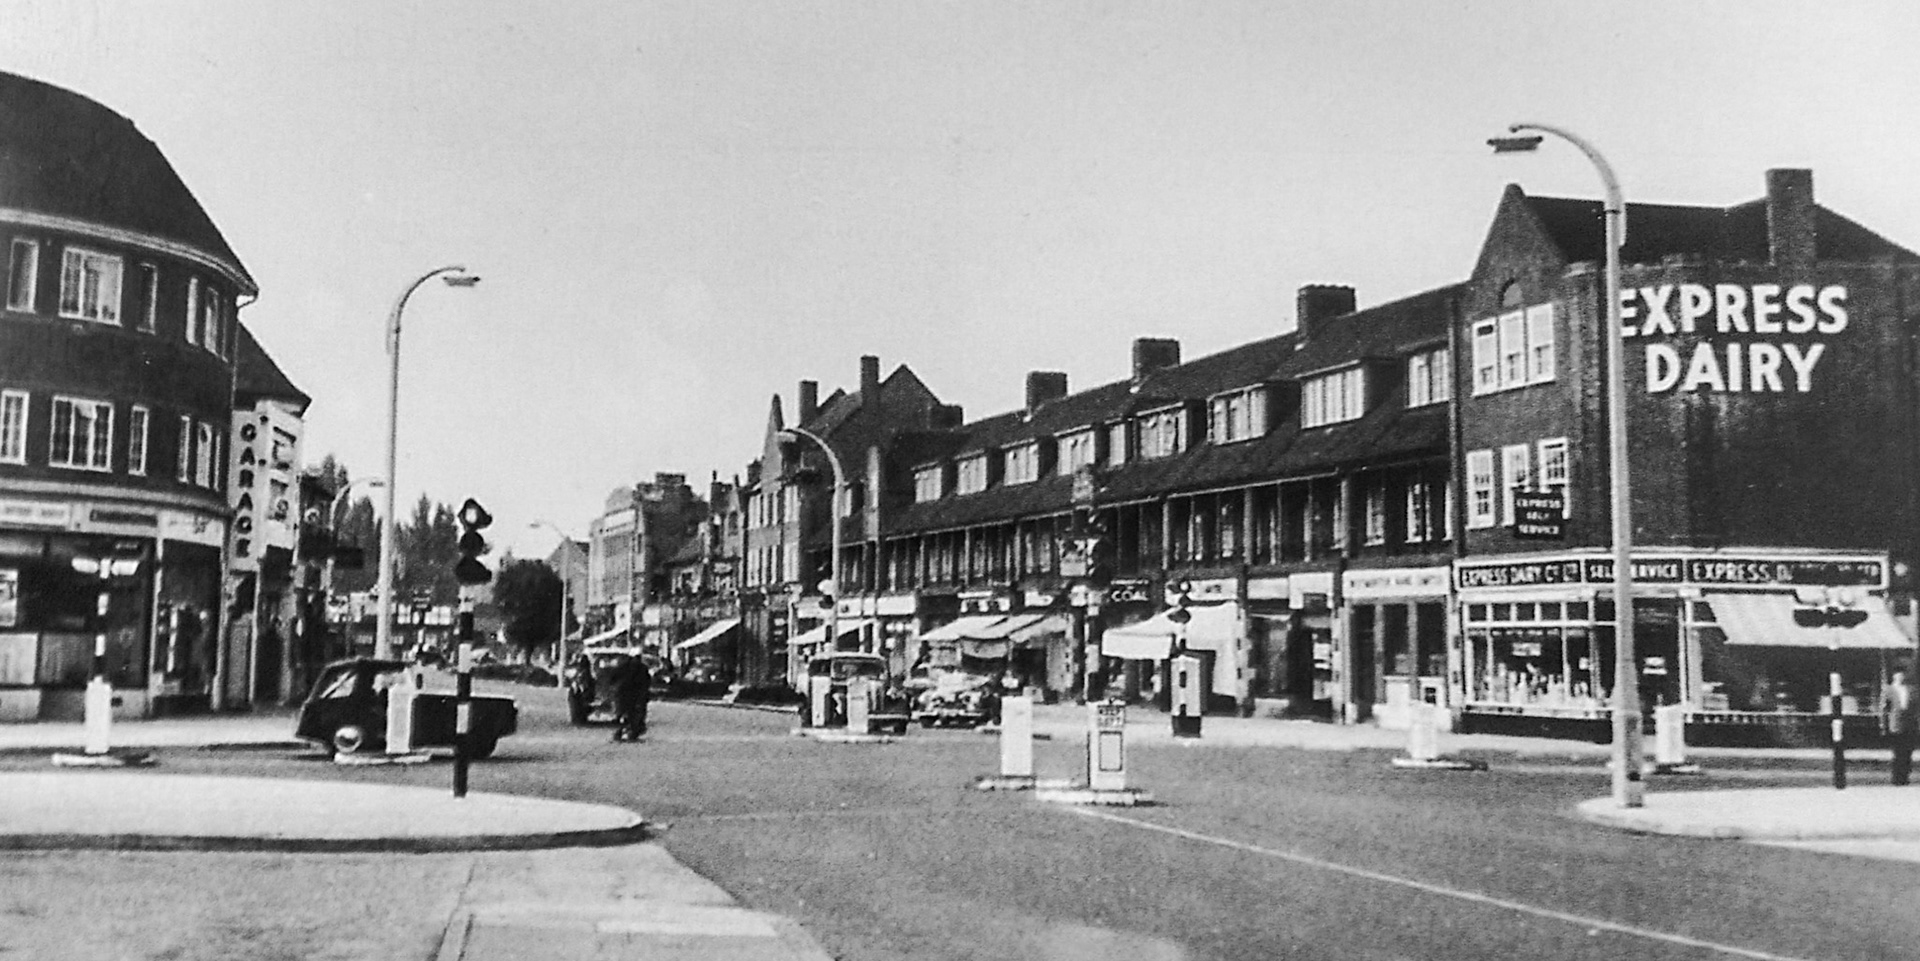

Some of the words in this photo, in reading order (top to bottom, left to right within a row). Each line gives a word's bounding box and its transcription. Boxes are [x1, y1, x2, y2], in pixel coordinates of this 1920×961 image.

[1620, 284, 1848, 337] EXPRESS
[1645, 342, 1825, 392] DAIRY
[235, 423, 257, 558] GARAGE
[1462, 567, 1508, 587] EXPRESS
[1589, 564, 1614, 579] SEL
[1630, 563, 1677, 579] ERVICE
[1692, 562, 1771, 581] EXPRESS
[1111, 590, 1149, 602] COAL
